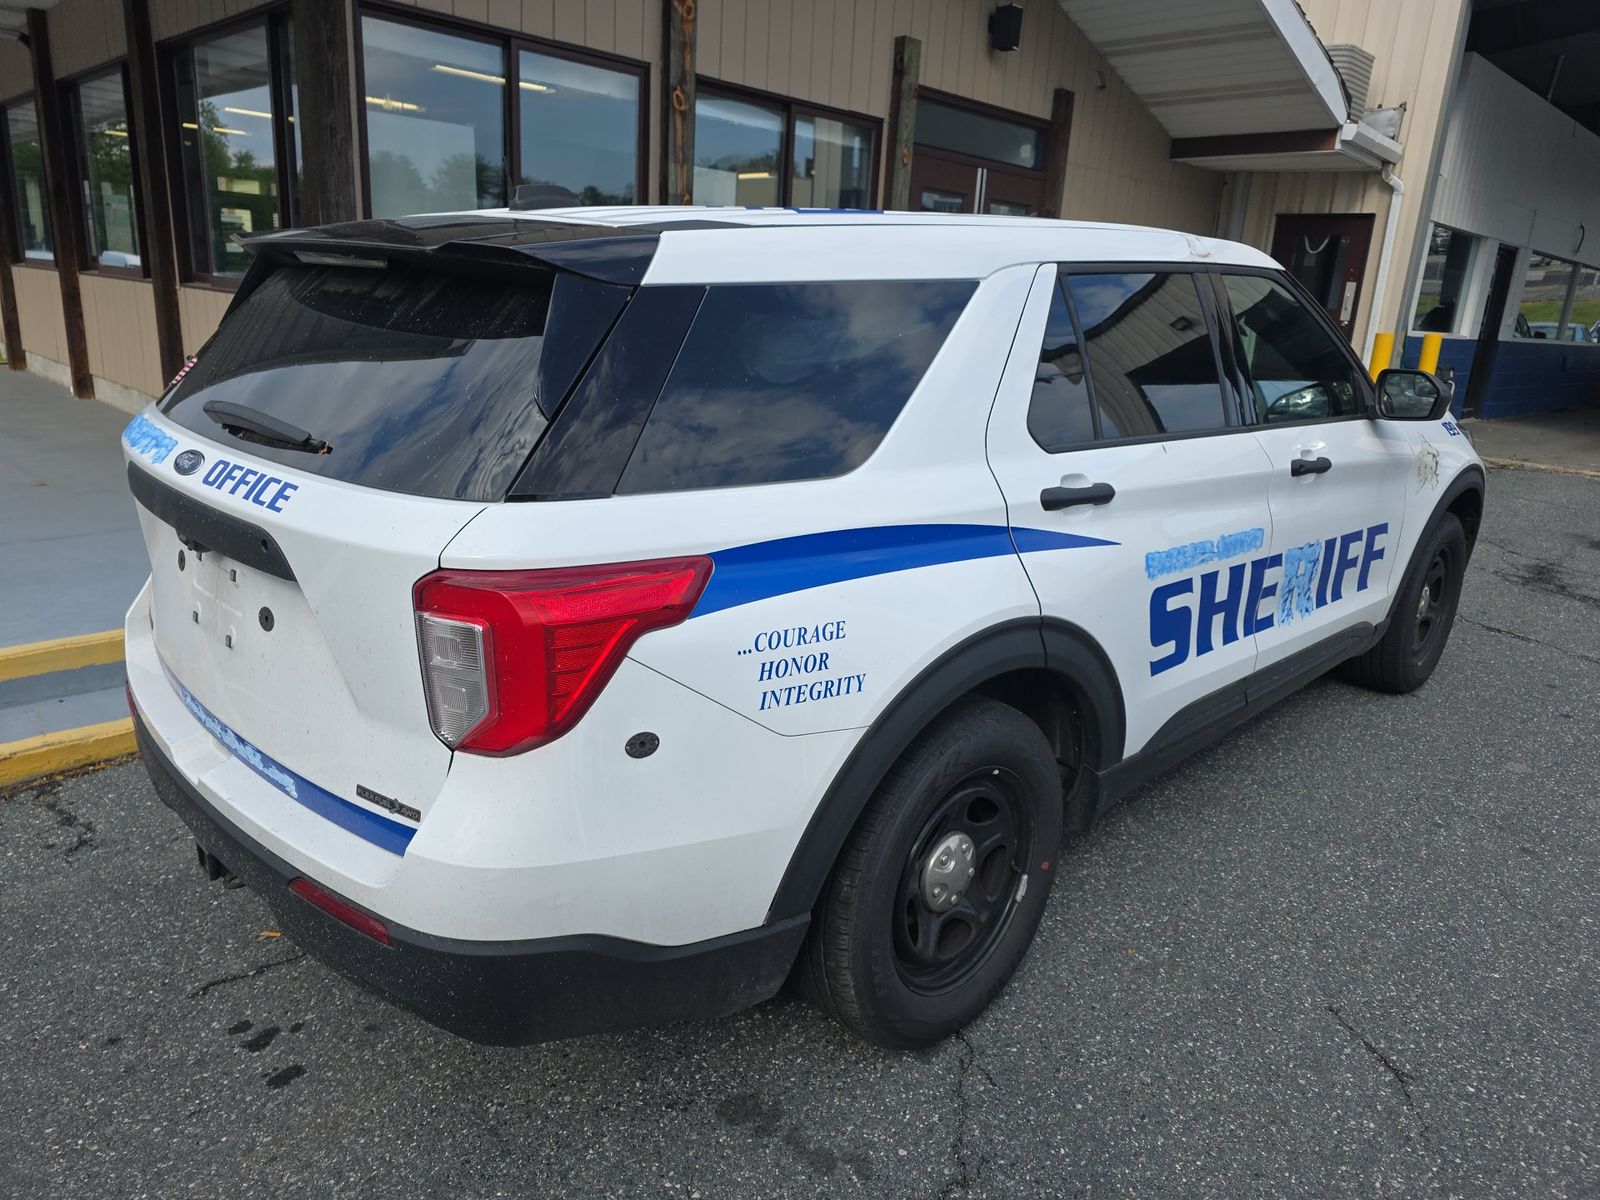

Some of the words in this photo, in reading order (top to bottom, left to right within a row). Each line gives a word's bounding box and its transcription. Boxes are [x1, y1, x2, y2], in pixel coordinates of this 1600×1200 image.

[202, 459, 299, 513] OFFICE
[758, 652, 829, 682] HONOR
[759, 673, 866, 711] INTEGRITY
